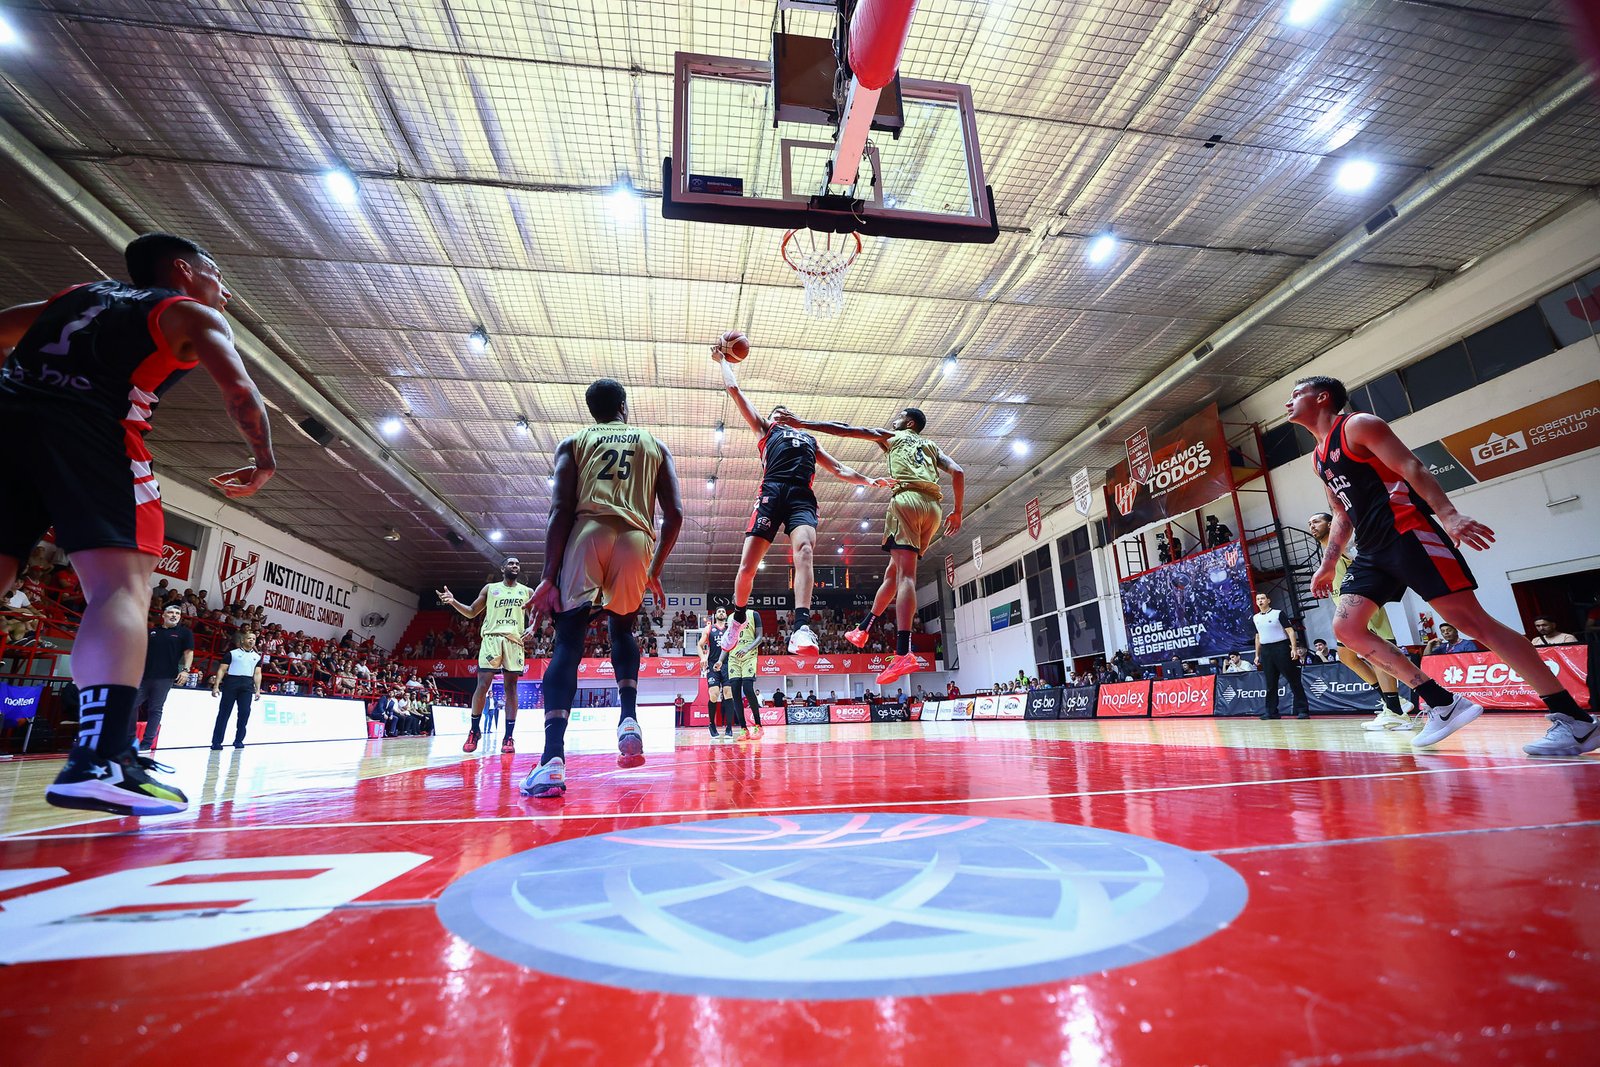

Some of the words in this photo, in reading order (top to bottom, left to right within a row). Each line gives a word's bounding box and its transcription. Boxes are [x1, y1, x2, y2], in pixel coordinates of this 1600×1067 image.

[1528, 407, 1600, 437] COBERTURA
[593, 433, 641, 449] JOHNSON
[1532, 434, 1548, 446] DE
[1548, 421, 1588, 442] SALUD
[1478, 438, 1520, 460] GEA
[597, 449, 635, 481] 25
[1146, 449, 1212, 494] TODOS
[1439, 464, 1455, 474] GEA
[263, 560, 325, 600] INSTITUTO
[263, 589, 295, 615] ESTADIO
[294, 599, 316, 622] ANGEL
[494, 598, 524, 609] LEONES
[504, 608, 513, 618] 11
[1130, 626, 1142, 637] LO
[1143, 621, 1163, 634] QUE
[1132, 635, 1144, 646] SE
[1144, 623, 1207, 644] CONQUISTA
[1133, 645, 1146, 656] SE
[1145, 636, 1199, 654] DEFIENDE.
[1101, 689, 1145, 709] moplex
[1156, 686, 1209, 709] moplex
[1236, 686, 1286, 699] Tecnod
